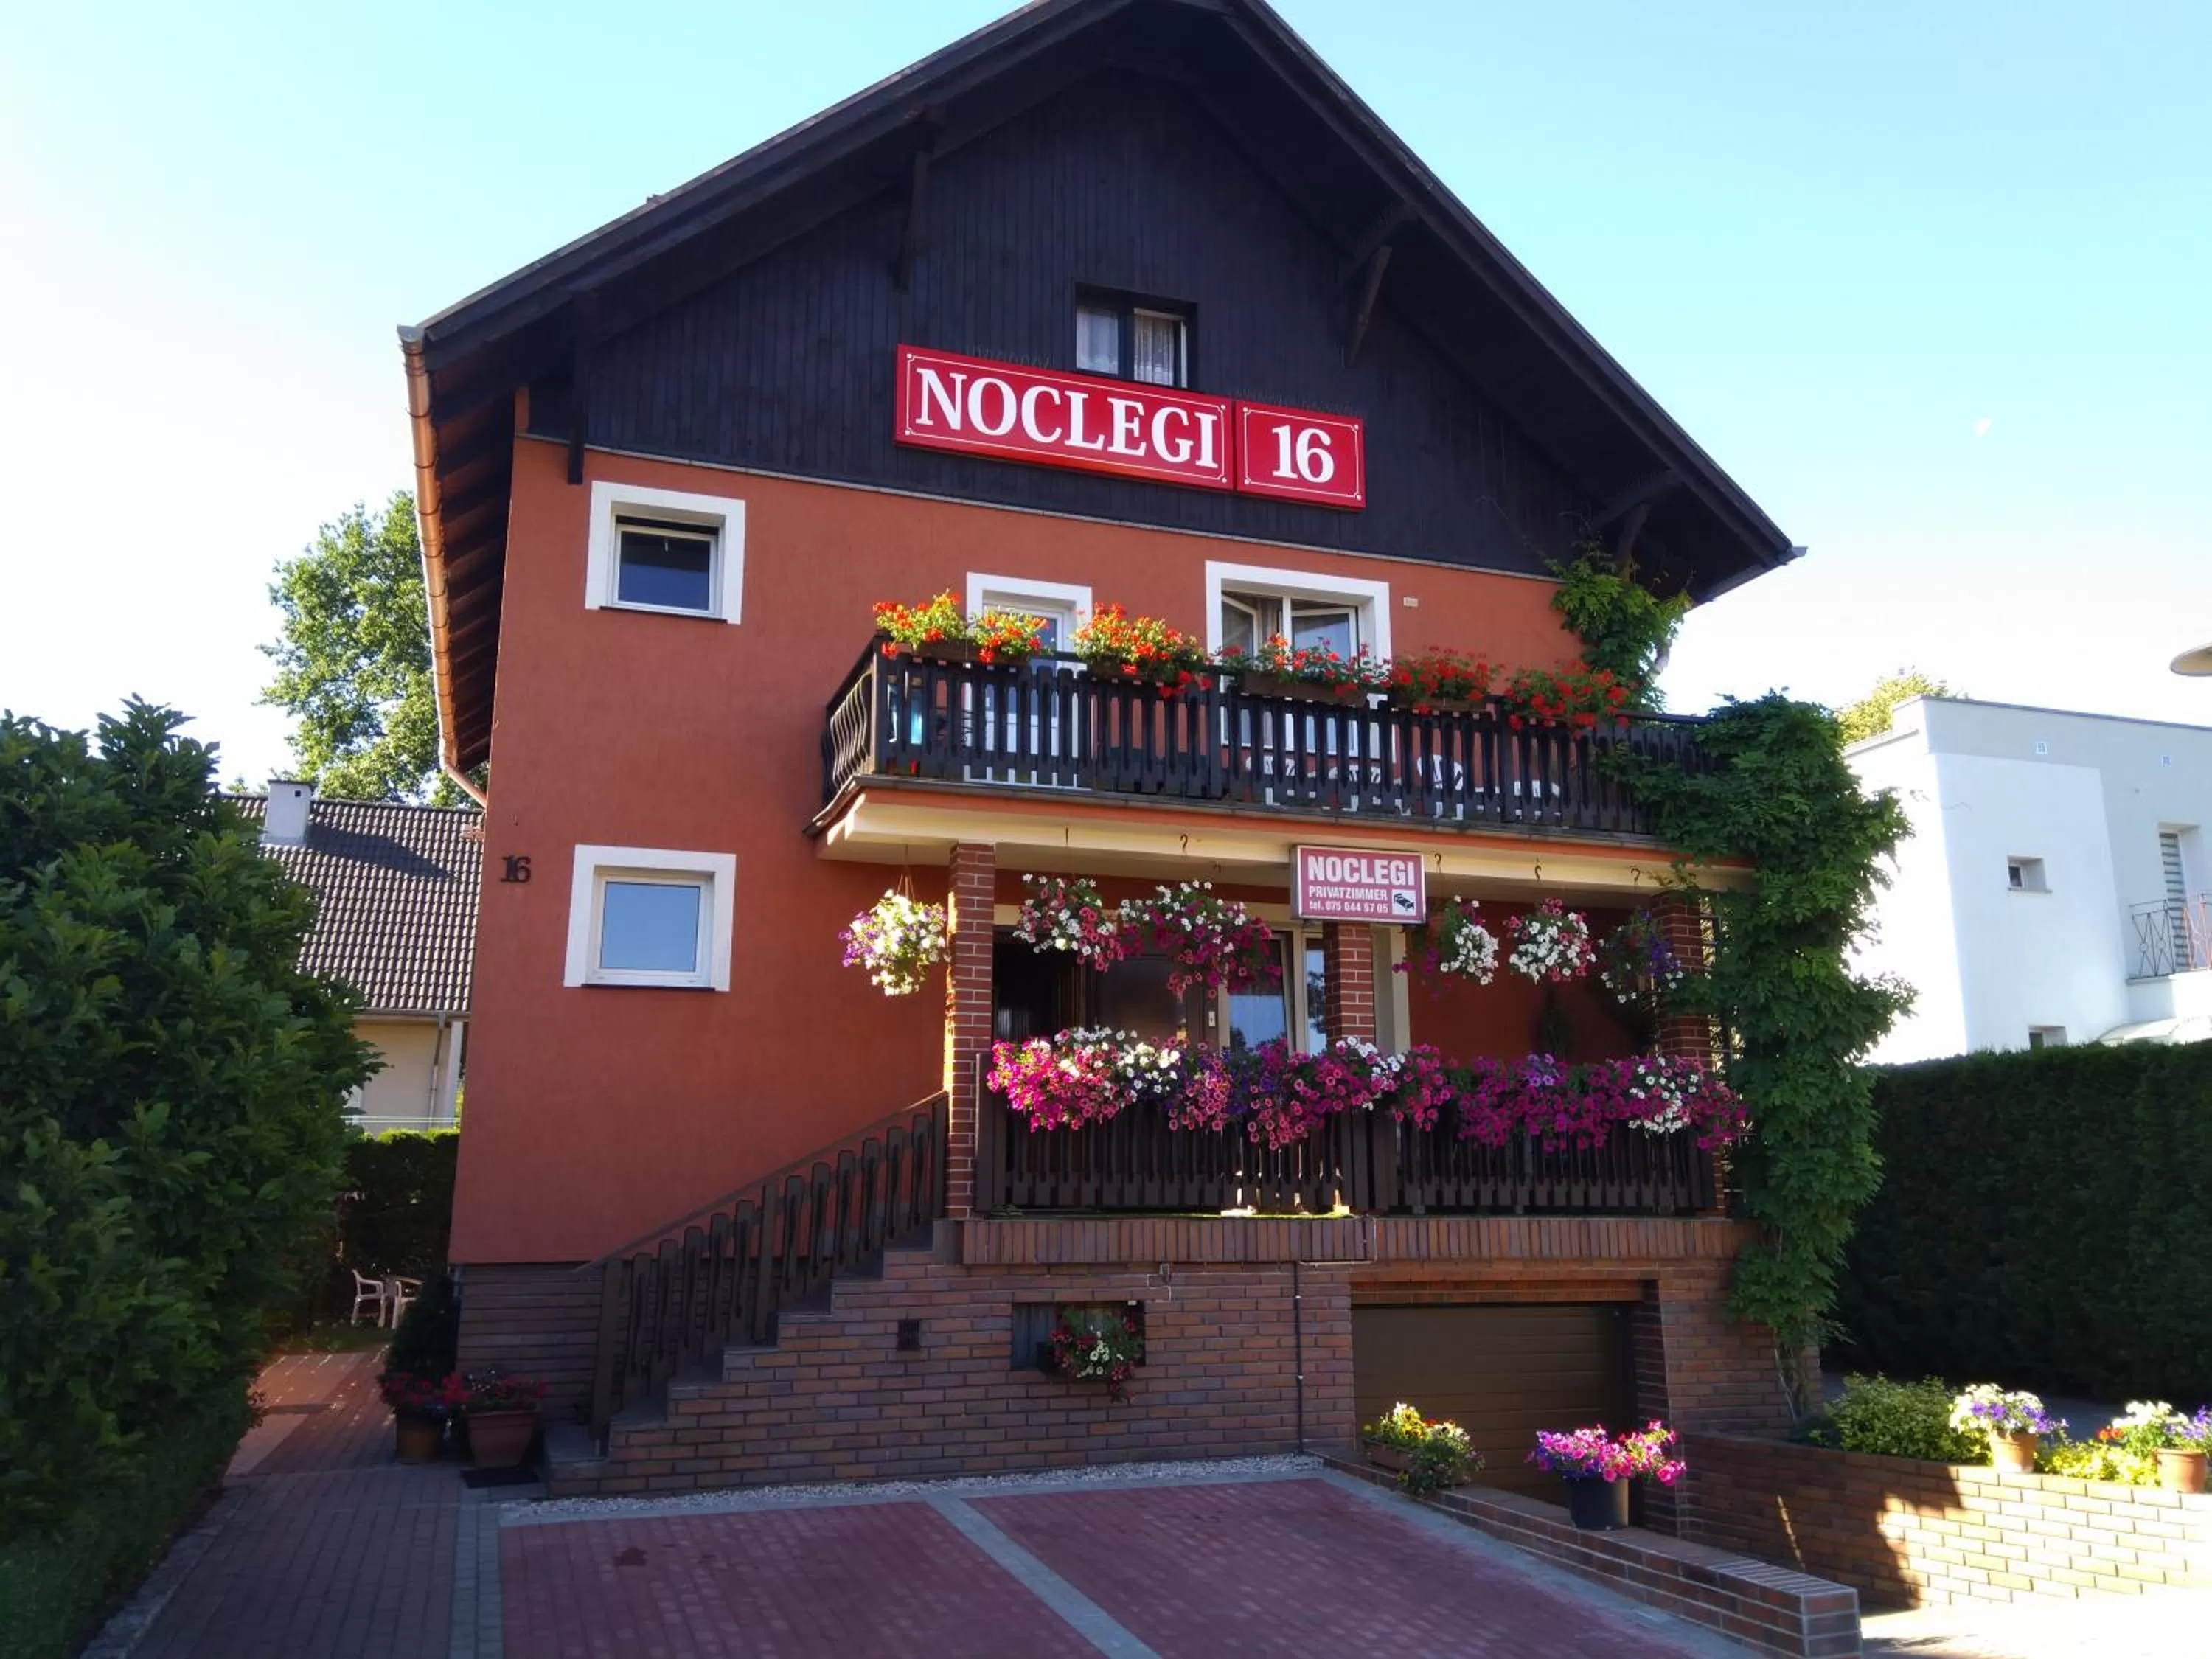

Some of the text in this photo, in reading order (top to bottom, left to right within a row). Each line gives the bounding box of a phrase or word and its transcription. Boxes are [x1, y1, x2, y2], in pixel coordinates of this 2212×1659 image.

[915, 369, 1218, 468] NOCLEGI
[1272, 425, 1334, 484] 16
[500, 855, 531, 883] 16
[1307, 855, 1415, 886] NOCLEGI
[1309, 886, 1388, 901] PRIVATZIMMER
[1377, 904, 1388, 914] 05
